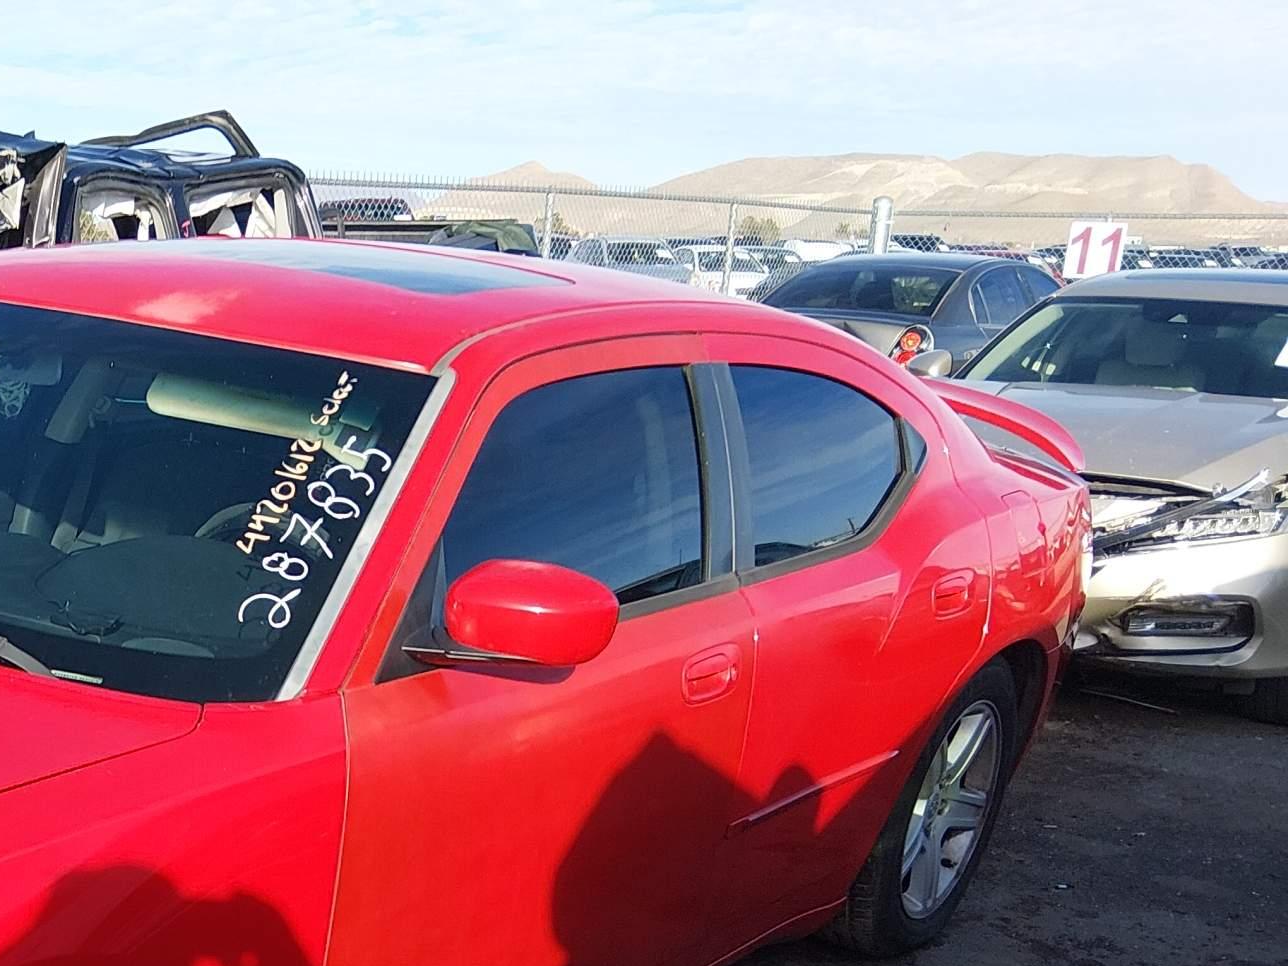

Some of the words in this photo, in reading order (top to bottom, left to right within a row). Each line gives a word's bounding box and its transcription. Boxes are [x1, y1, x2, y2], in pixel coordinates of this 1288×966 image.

[1071, 226, 1123, 274] 11
[235, 438, 323, 554] 44201612
[237, 435, 392, 629] 287835
